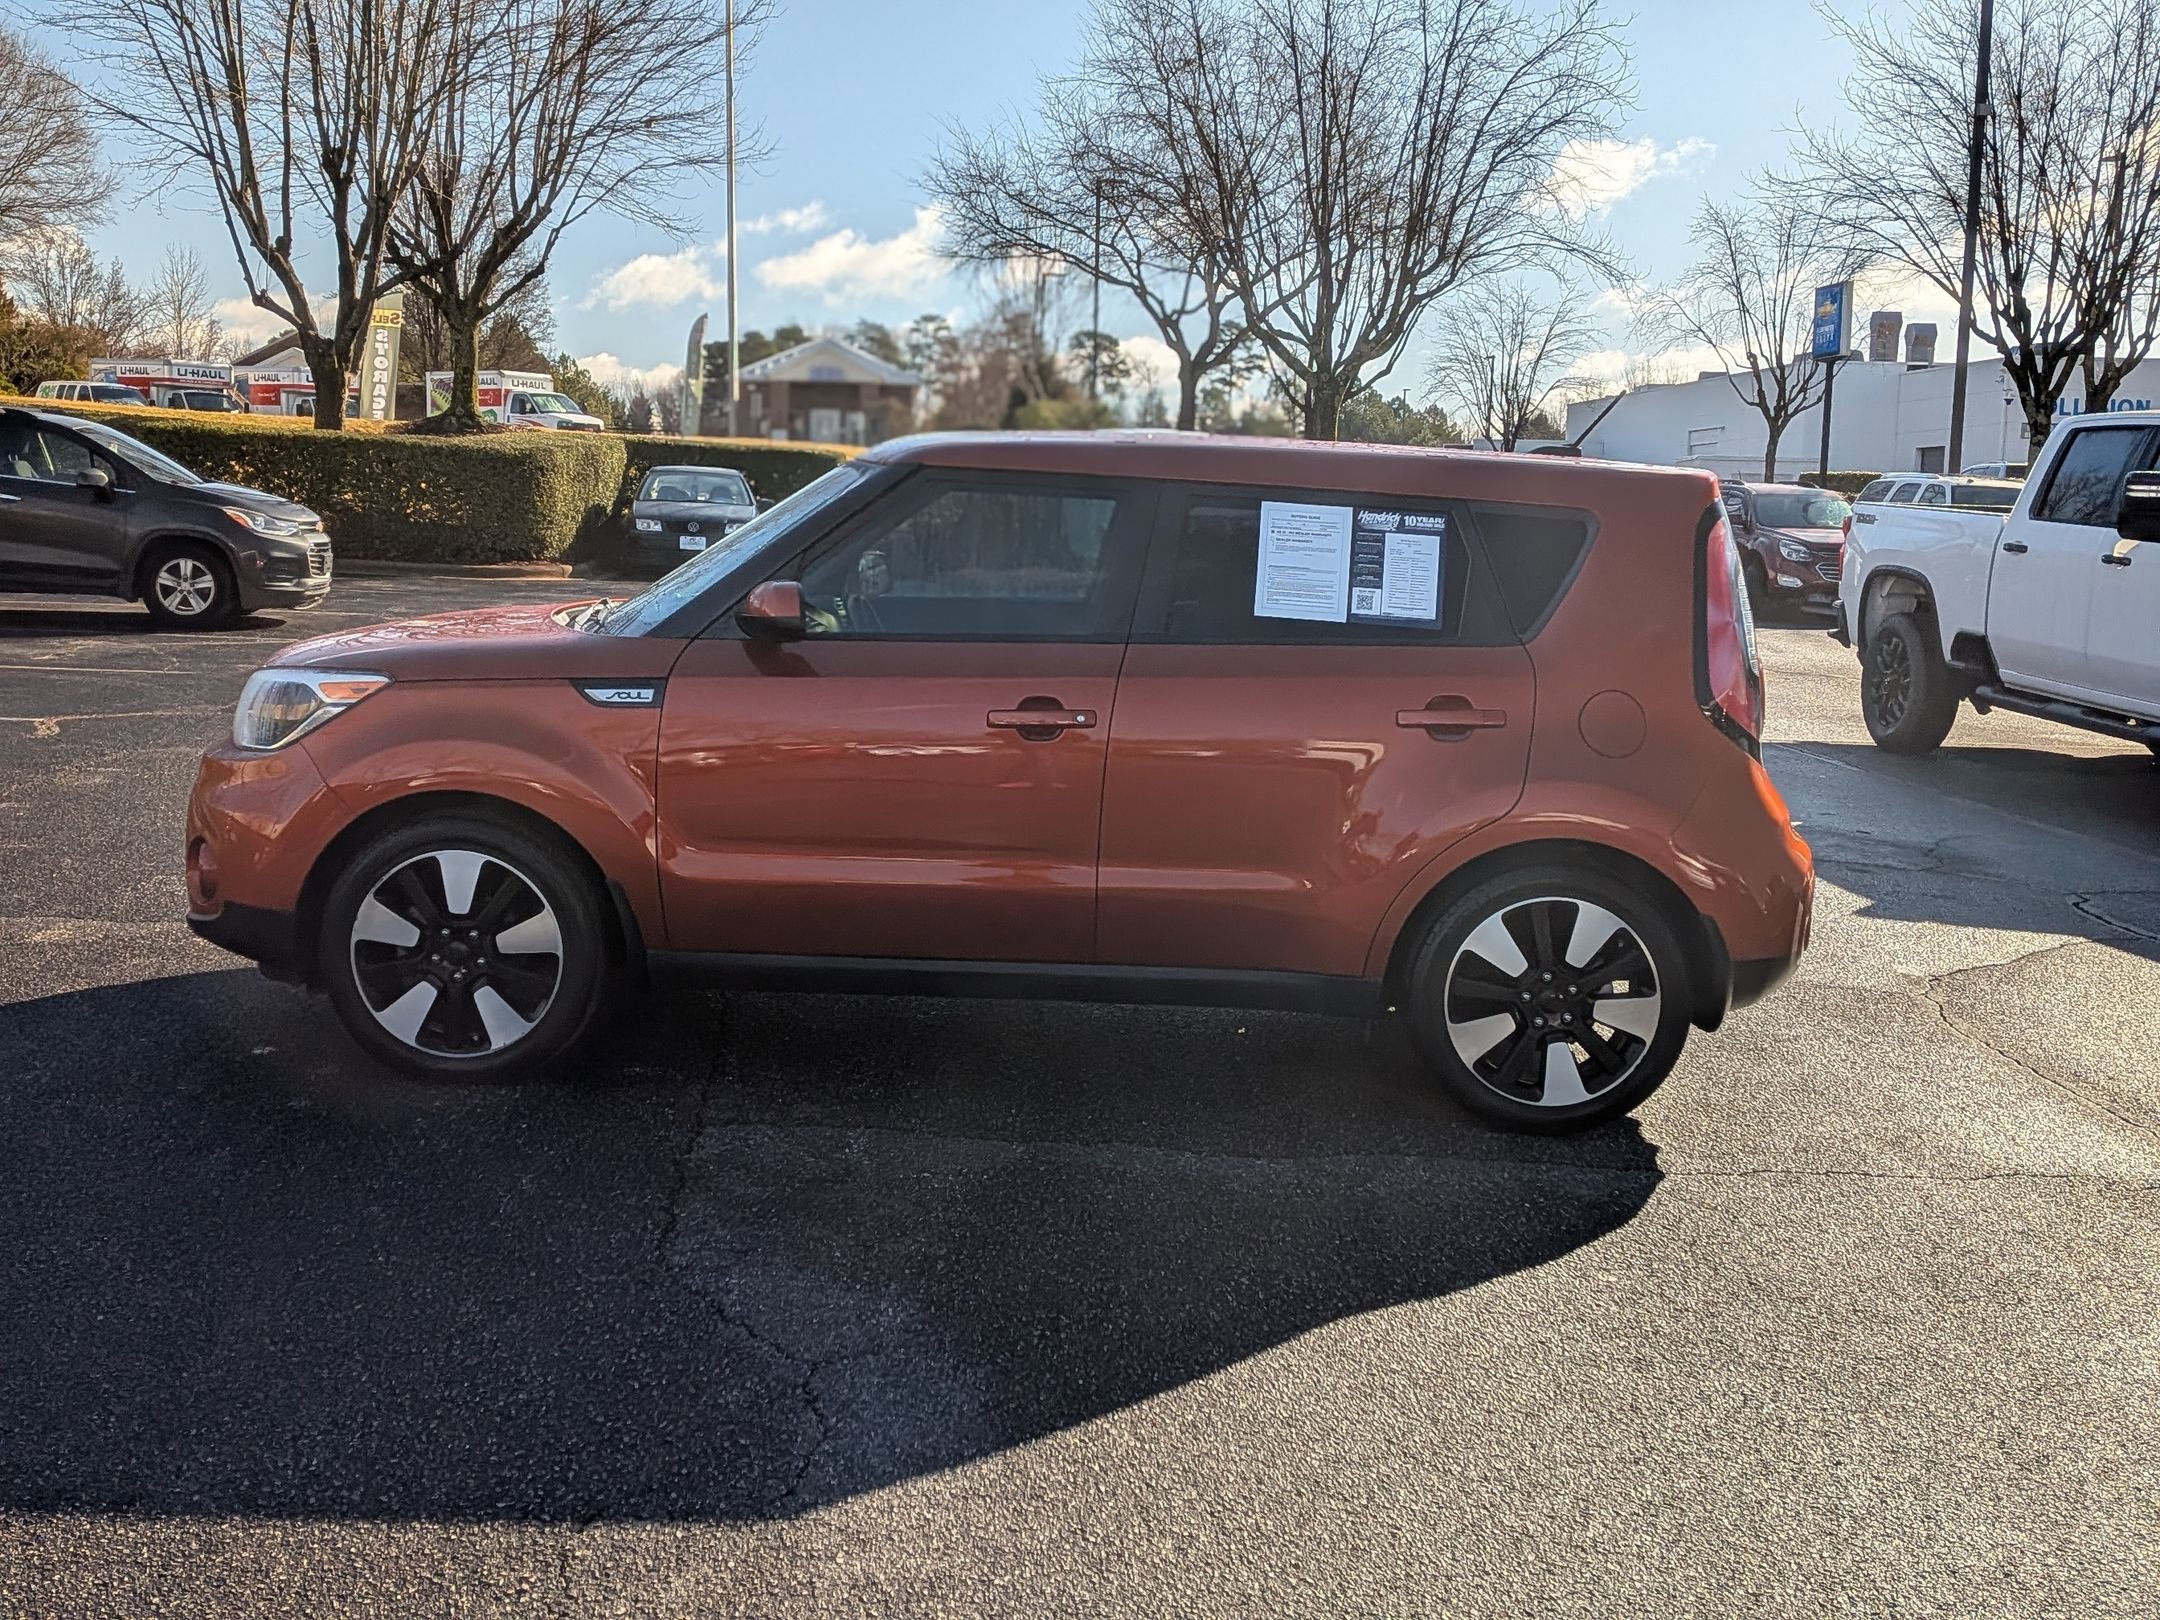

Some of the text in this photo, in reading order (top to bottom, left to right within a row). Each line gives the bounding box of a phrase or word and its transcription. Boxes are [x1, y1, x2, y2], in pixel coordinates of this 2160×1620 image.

[120, 366, 150, 376] U-HAUL
[177, 367, 226, 380] U-HAUL
[253, 373, 281, 382] U-HAUL
[511, 379, 546, 390] U-HAUL
[1403, 515, 1417, 527] 10
[605, 691, 650, 700] SOUL
